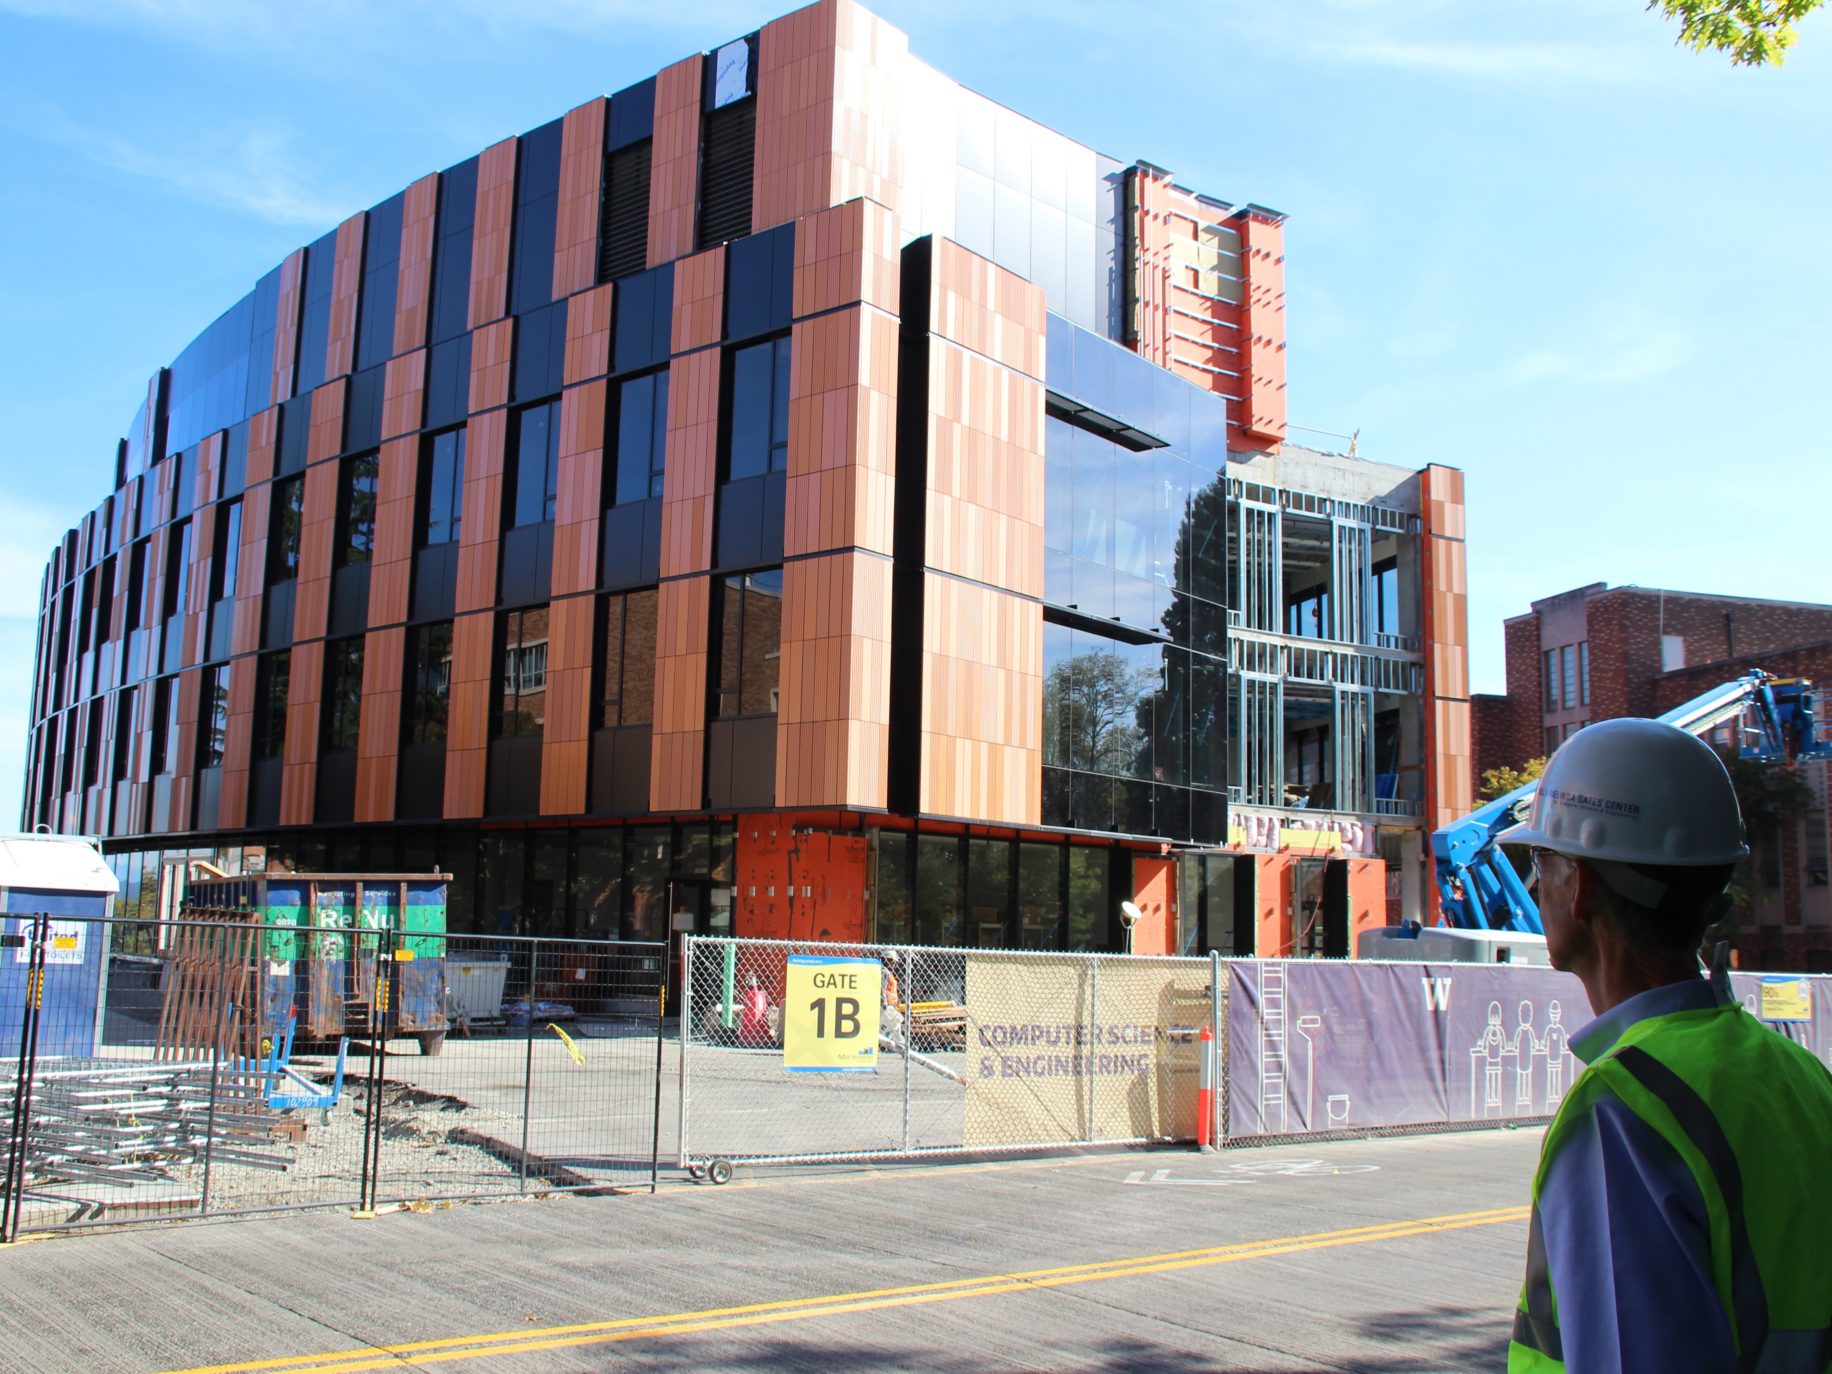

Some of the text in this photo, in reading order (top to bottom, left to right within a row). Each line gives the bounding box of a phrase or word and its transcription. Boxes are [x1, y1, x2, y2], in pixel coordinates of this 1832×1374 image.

[1578, 794, 1602, 807] GATES
[1605, 799, 1640, 815] CENTER
[813, 973, 857, 989] GATE
[1421, 977, 1452, 1011] W
[810, 997, 860, 1038] 1B
[978, 1024, 1193, 1046] COMPUTER SCIENCE
[979, 1053, 1151, 1079] & ENGINEERING
